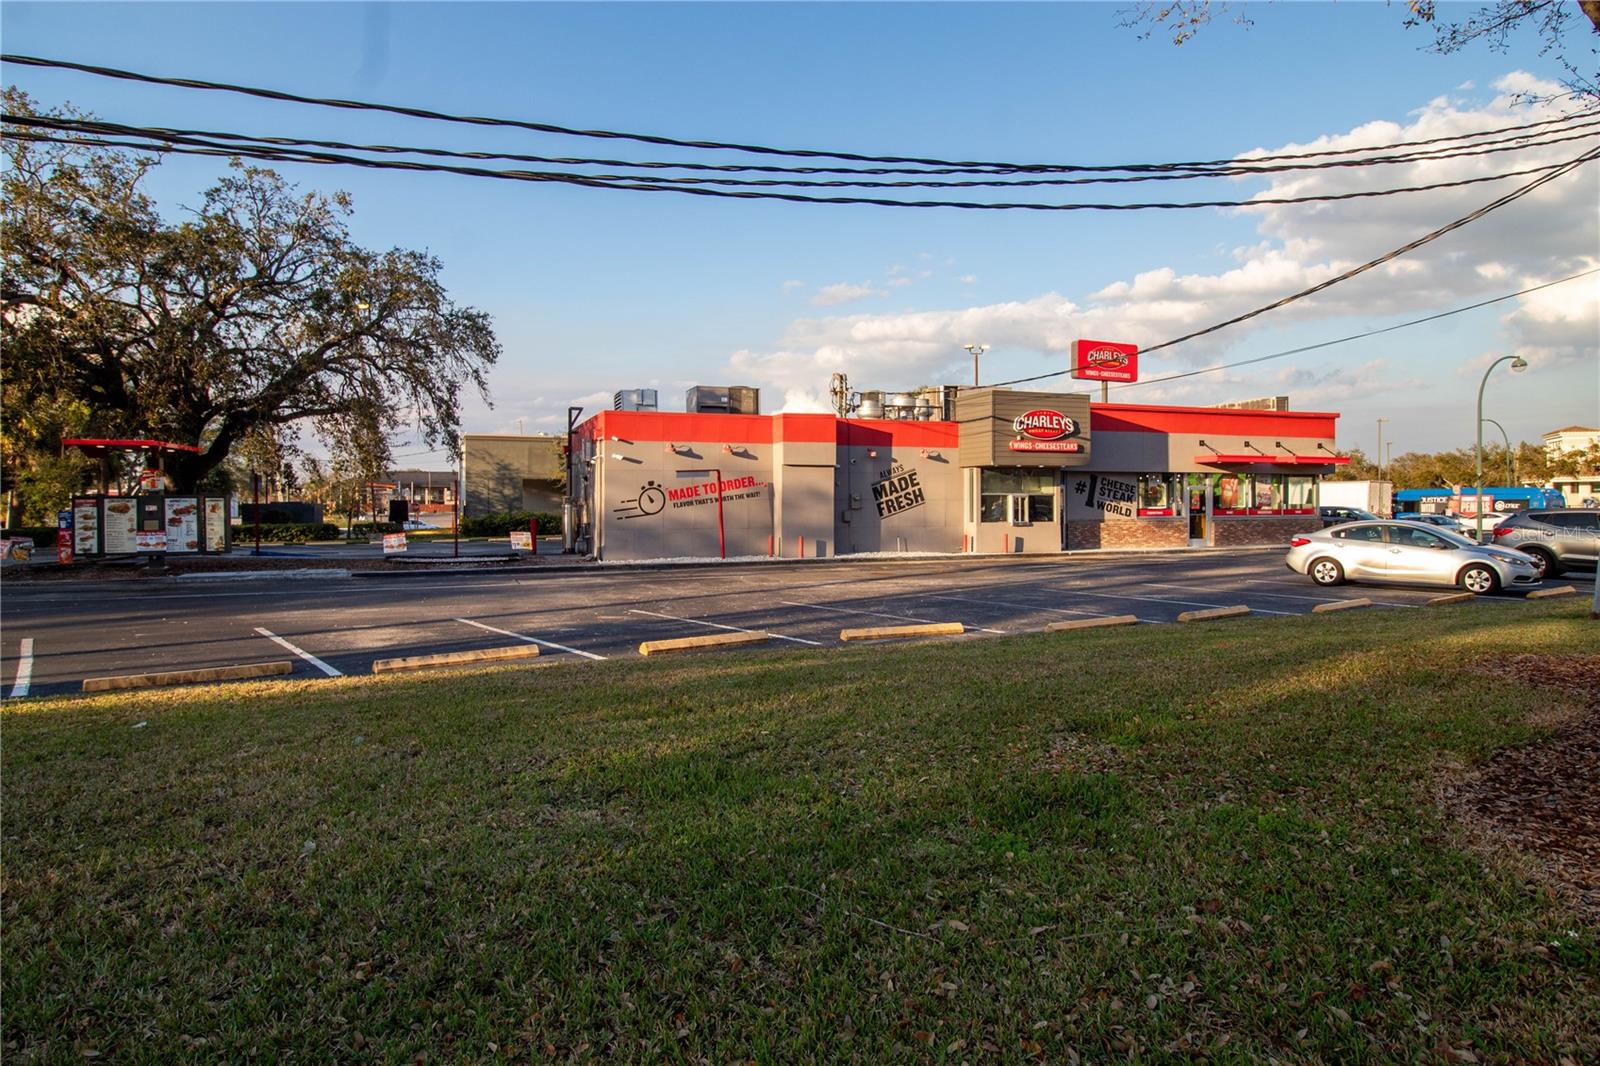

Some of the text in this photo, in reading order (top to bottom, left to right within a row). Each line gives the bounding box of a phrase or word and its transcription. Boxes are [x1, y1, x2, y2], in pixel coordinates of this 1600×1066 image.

[1088, 350, 1128, 366] CHARLEYS
[1014, 415, 1074, 433] CHARLEYS
[880, 464, 904, 478] ALWAYS
[668, 485, 701, 501] MADE
[702, 482, 717, 496] TO
[872, 472, 920, 501] MADE
[1100, 477, 1137, 494] CHEESE
[673, 499, 694, 508] FLAVOR
[695, 497, 714, 506] THAT'S
[714, 494, 733, 503] WRTH
[734, 493, 745, 501] THE
[876, 488, 925, 517] FRESH
[1099, 486, 1135, 505] STEAK
[1097, 500, 1132, 517] WORLD
